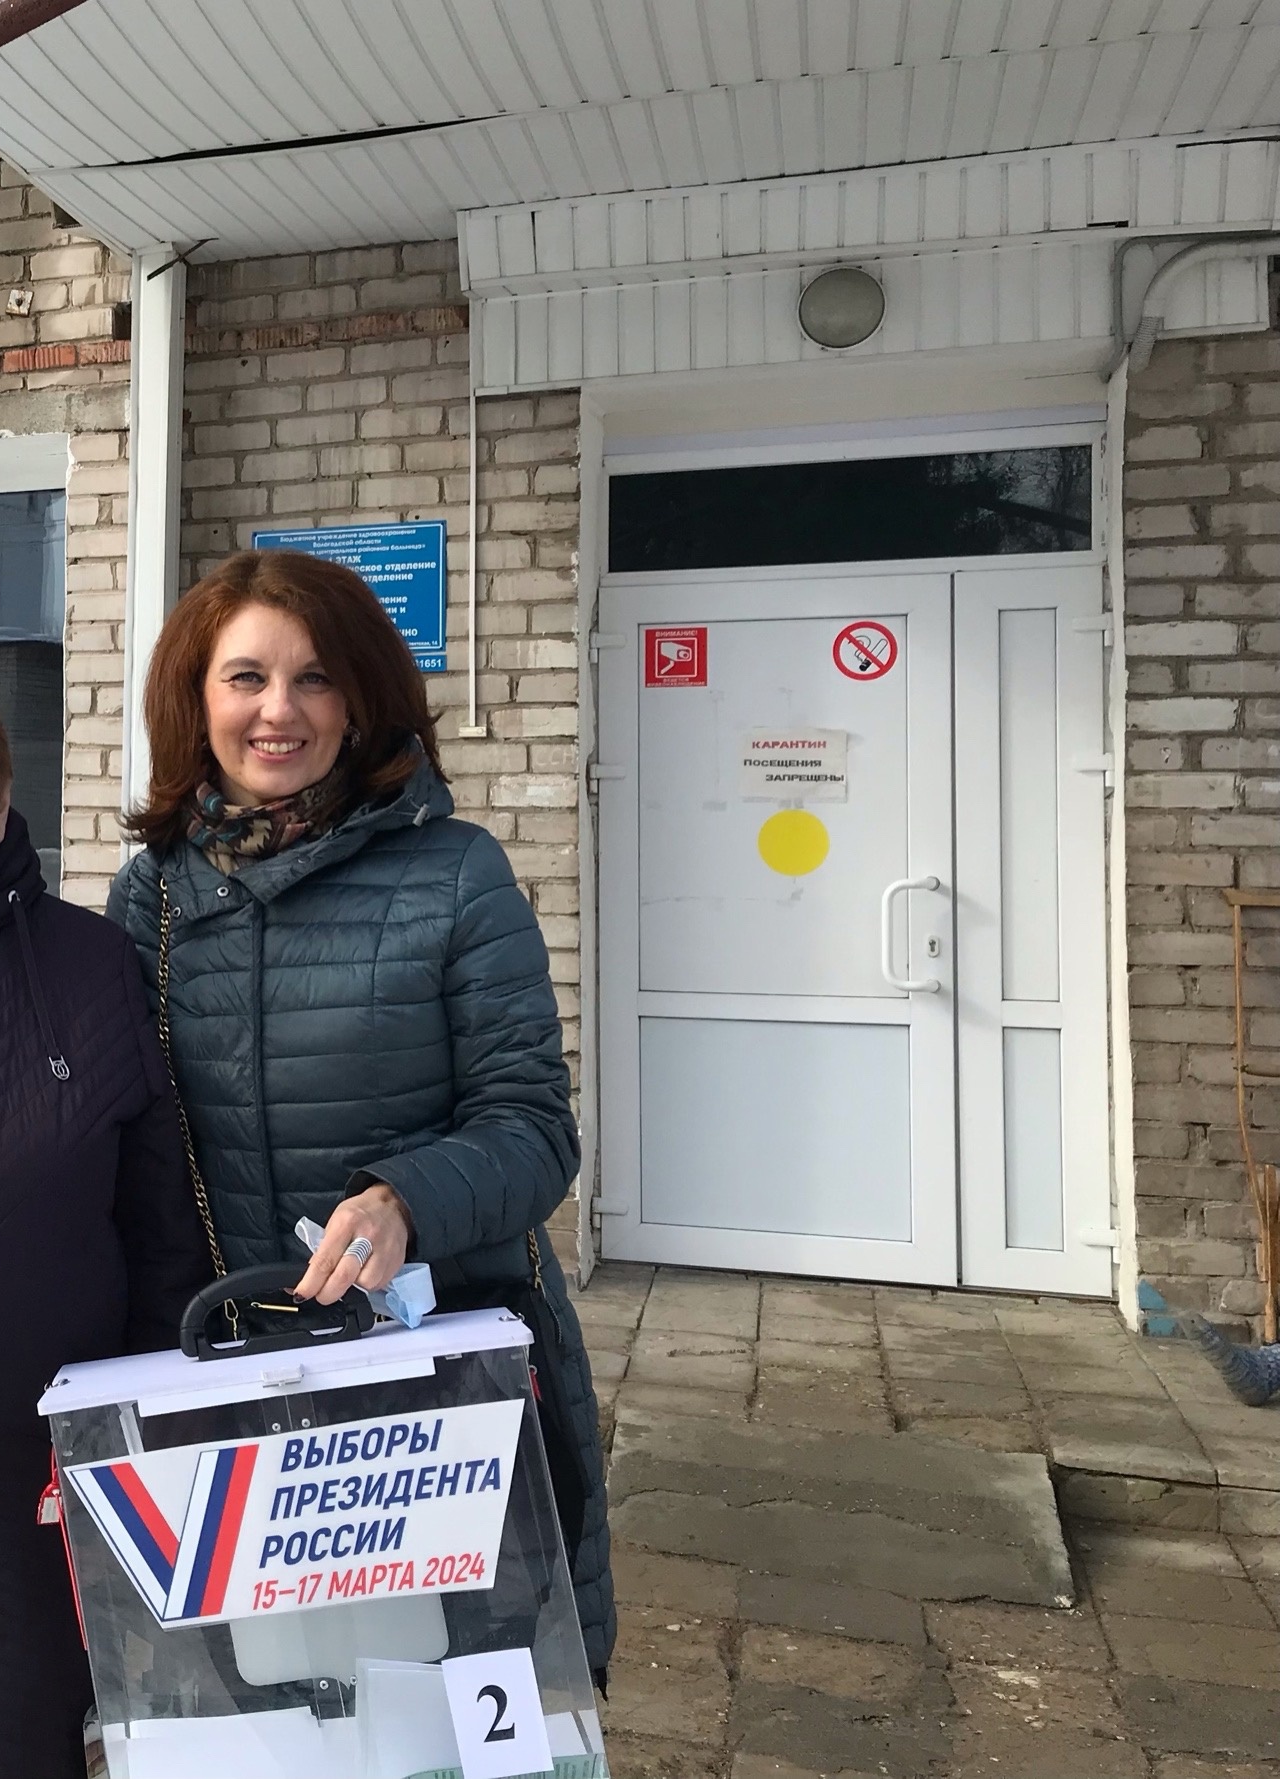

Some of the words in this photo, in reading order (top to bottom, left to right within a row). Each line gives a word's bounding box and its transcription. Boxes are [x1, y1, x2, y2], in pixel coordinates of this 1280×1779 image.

[335, 554, 362, 565] ЭТАЖ
[384, 561, 437, 572] отделение
[361, 573, 414, 584] отделение
[751, 740, 827, 750] КАРАНТИН
[743, 759, 823, 768] ПОСЕЩЕНИЯ
[765, 773, 845, 783] ЗАПРЕЩЕНЫ
[280, 1418, 443, 1473] ВЫБОРЫ
[269, 1457, 502, 1521] ПРЕЗИДЕНТА
[259, 1516, 407, 1569] РОССИИ
[327, 1560, 415, 1599] МАРТА
[422, 1552, 486, 1588] 2024
[476, 1684, 516, 1743] 2
